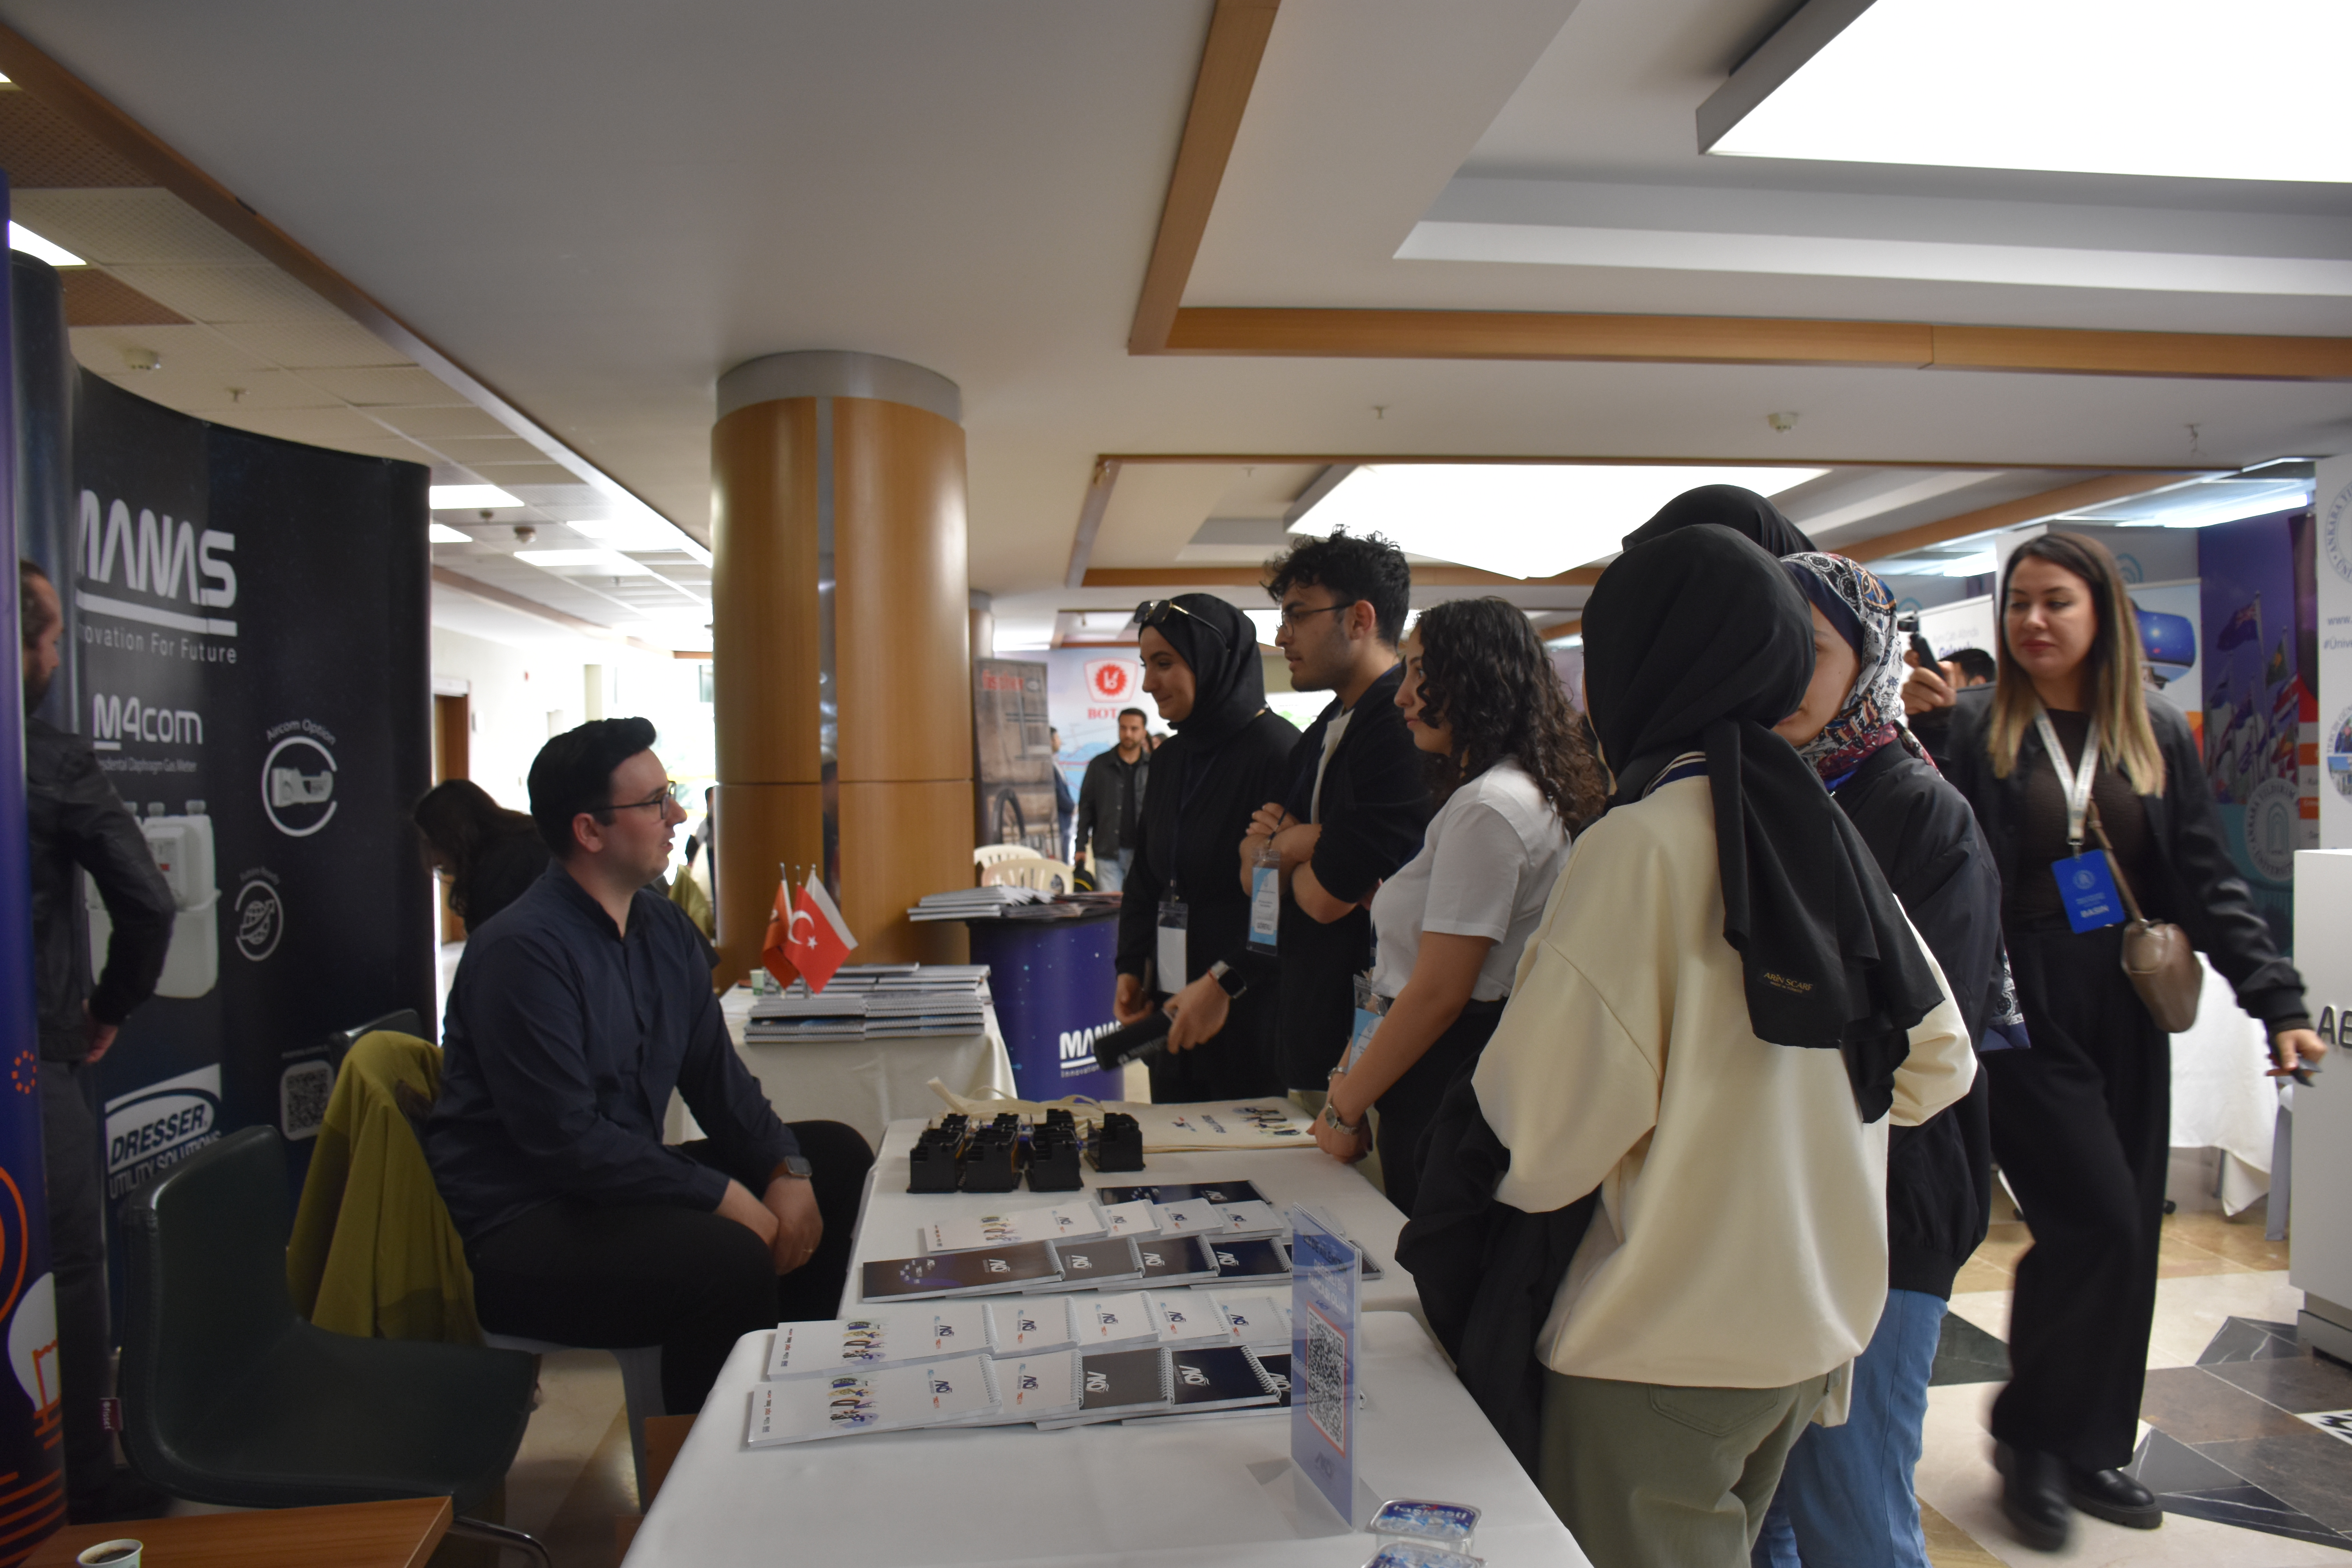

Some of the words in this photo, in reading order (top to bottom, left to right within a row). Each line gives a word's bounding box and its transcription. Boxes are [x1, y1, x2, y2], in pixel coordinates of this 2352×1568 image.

[85, 626, 145, 652] ovation
[151, 632, 175, 657] For
[180, 637, 237, 664] Future
[93, 692, 203, 744] M4com
[1088, 707, 1117, 719] BOT
[266, 720, 301, 742] Aircom
[301, 718, 336, 745] Option
[1785, 978, 1814, 991] SCARF
[111, 1103, 205, 1165] DRESSER
